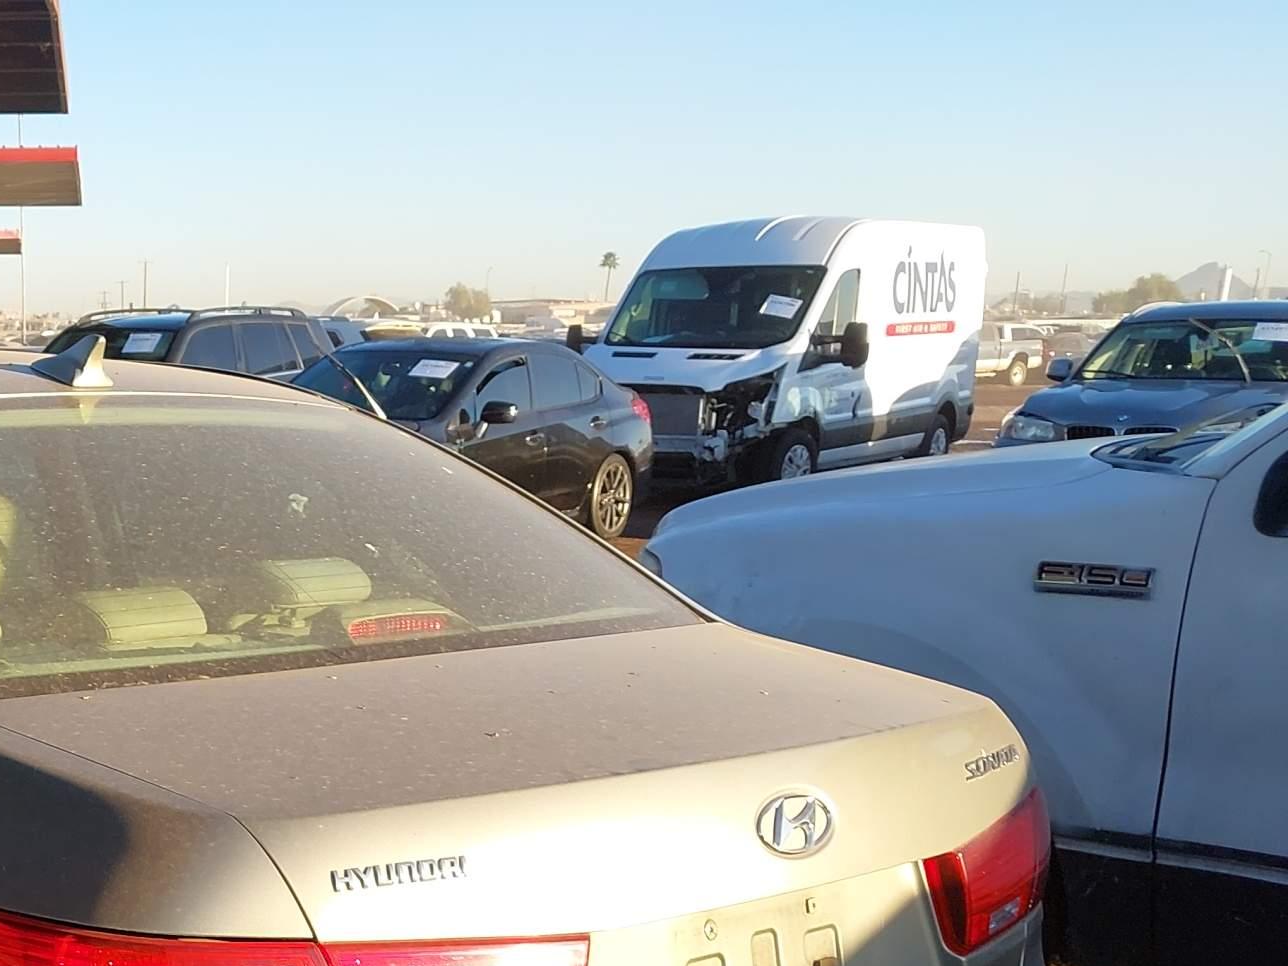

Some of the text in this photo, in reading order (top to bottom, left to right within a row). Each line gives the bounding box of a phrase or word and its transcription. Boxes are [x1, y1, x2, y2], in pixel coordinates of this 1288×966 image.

[893, 245, 956, 314] CINTAS
[964, 744, 1020, 781] SONATA
[330, 855, 468, 893] HYUNDAI
